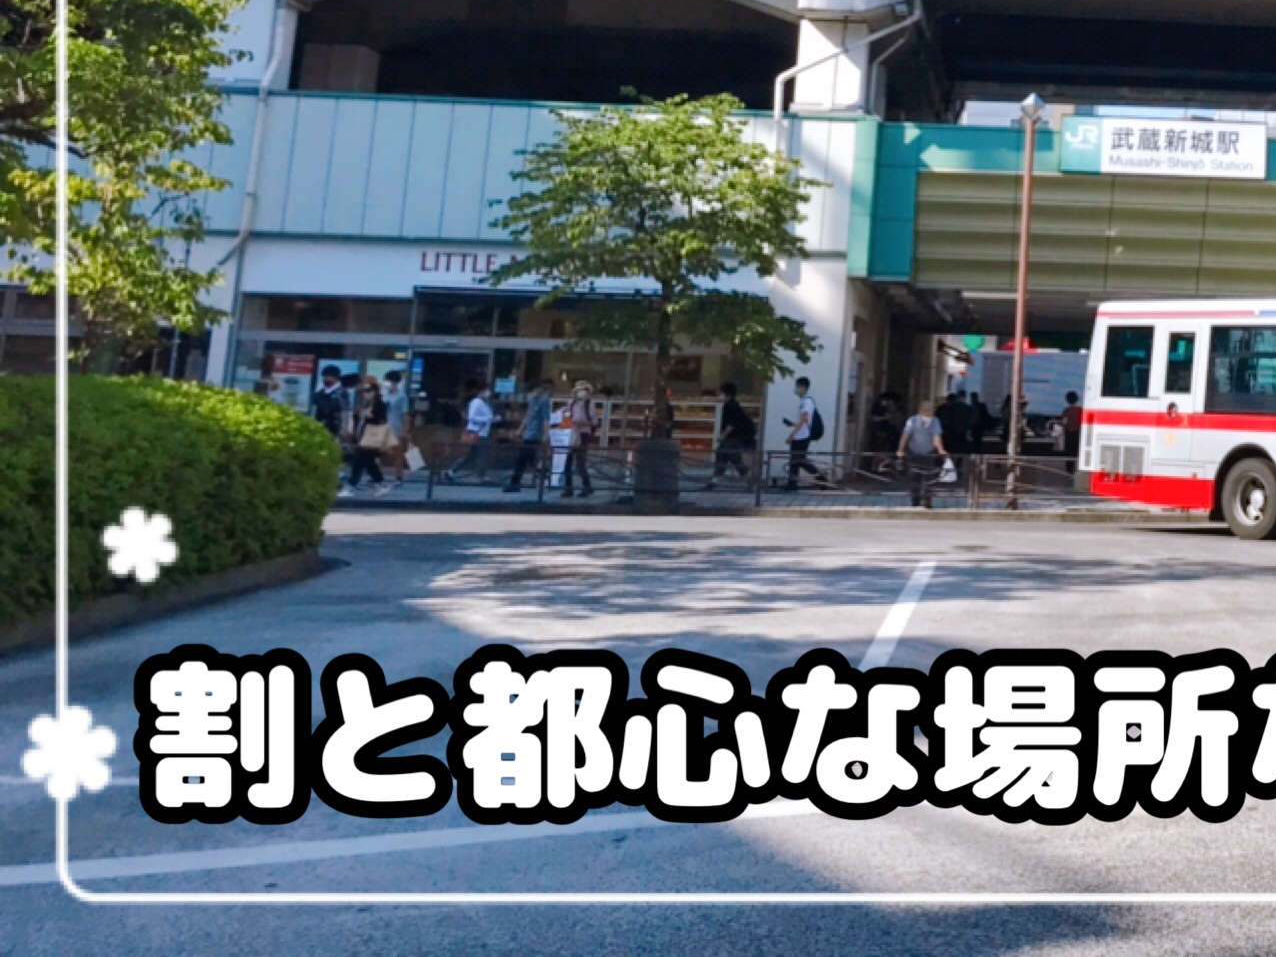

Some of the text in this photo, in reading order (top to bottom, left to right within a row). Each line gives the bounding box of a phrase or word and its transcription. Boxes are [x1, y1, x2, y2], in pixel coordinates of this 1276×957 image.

[1065, 125, 1098, 143] JR
[1110, 127, 1239, 154] 武蔵新城駅
[1210, 158, 1253, 171] Station
[420, 251, 498, 273] LITTLE
